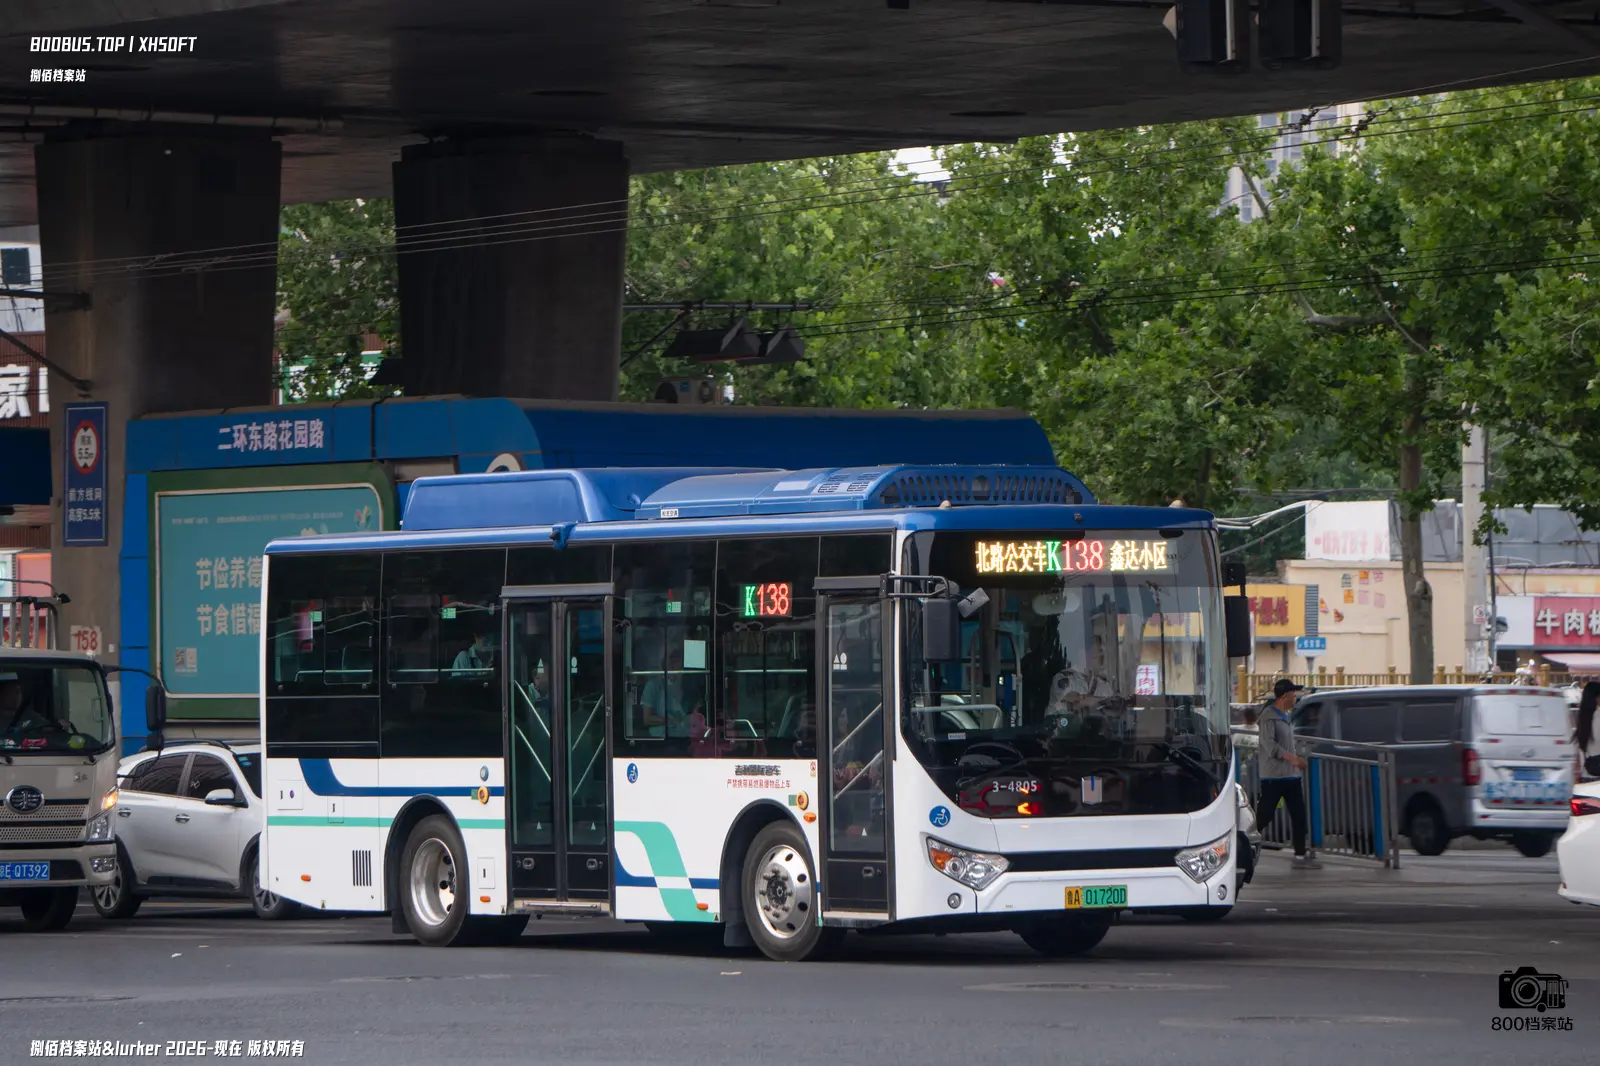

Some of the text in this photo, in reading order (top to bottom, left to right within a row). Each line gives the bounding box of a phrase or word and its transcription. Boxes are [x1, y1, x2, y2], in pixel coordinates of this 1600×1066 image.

[0, 363, 50, 419] 家
[218, 418, 324, 452] 二环东路花园路
[195, 556, 262, 590] 节俭养德
[1110, 540, 1169, 572] 鑫达小区
[744, 582, 790, 616] K138
[196, 603, 261, 637] 节食惜福
[992, 780, 1038, 793] 3-4805
